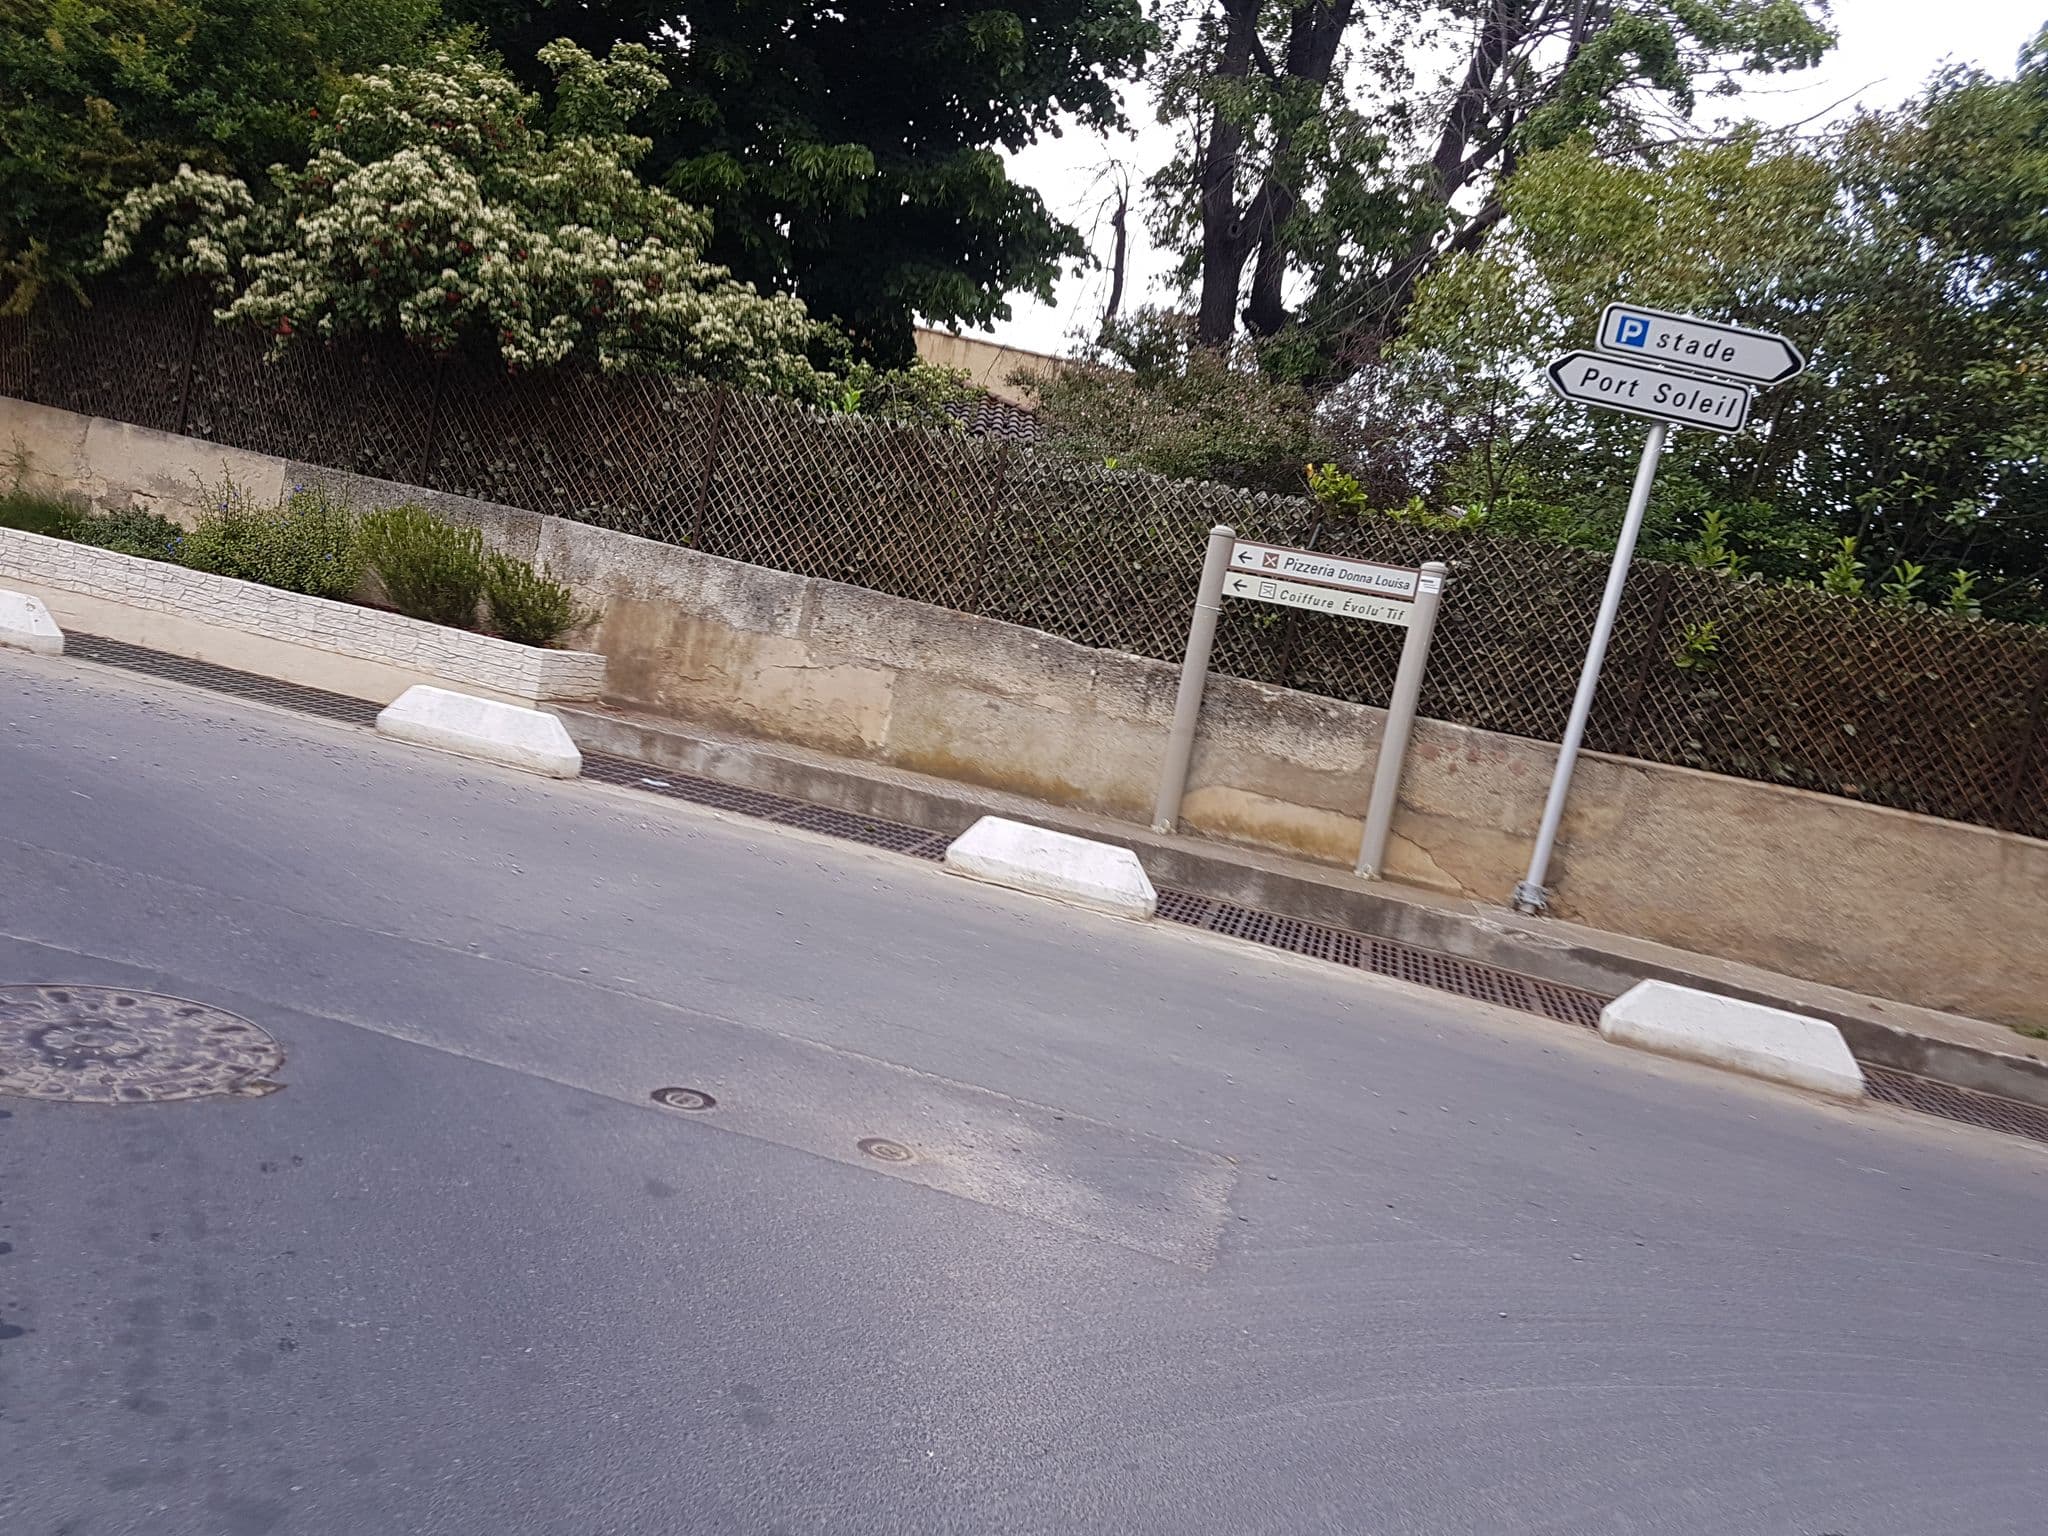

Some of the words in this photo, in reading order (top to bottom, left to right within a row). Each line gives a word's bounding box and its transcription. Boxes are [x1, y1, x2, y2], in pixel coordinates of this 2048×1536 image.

[1619, 321, 1644, 343] P
[1656, 333, 1736, 362] stade
[1579, 368, 1639, 398] Port
[1653, 384, 1738, 418] Soleil
[1283, 557, 1335, 578] Pizzeria
[1338, 569, 1373, 585] Donna
[1375, 574, 1410, 590] Louisa
[1280, 590, 1335, 609] Coiffure
